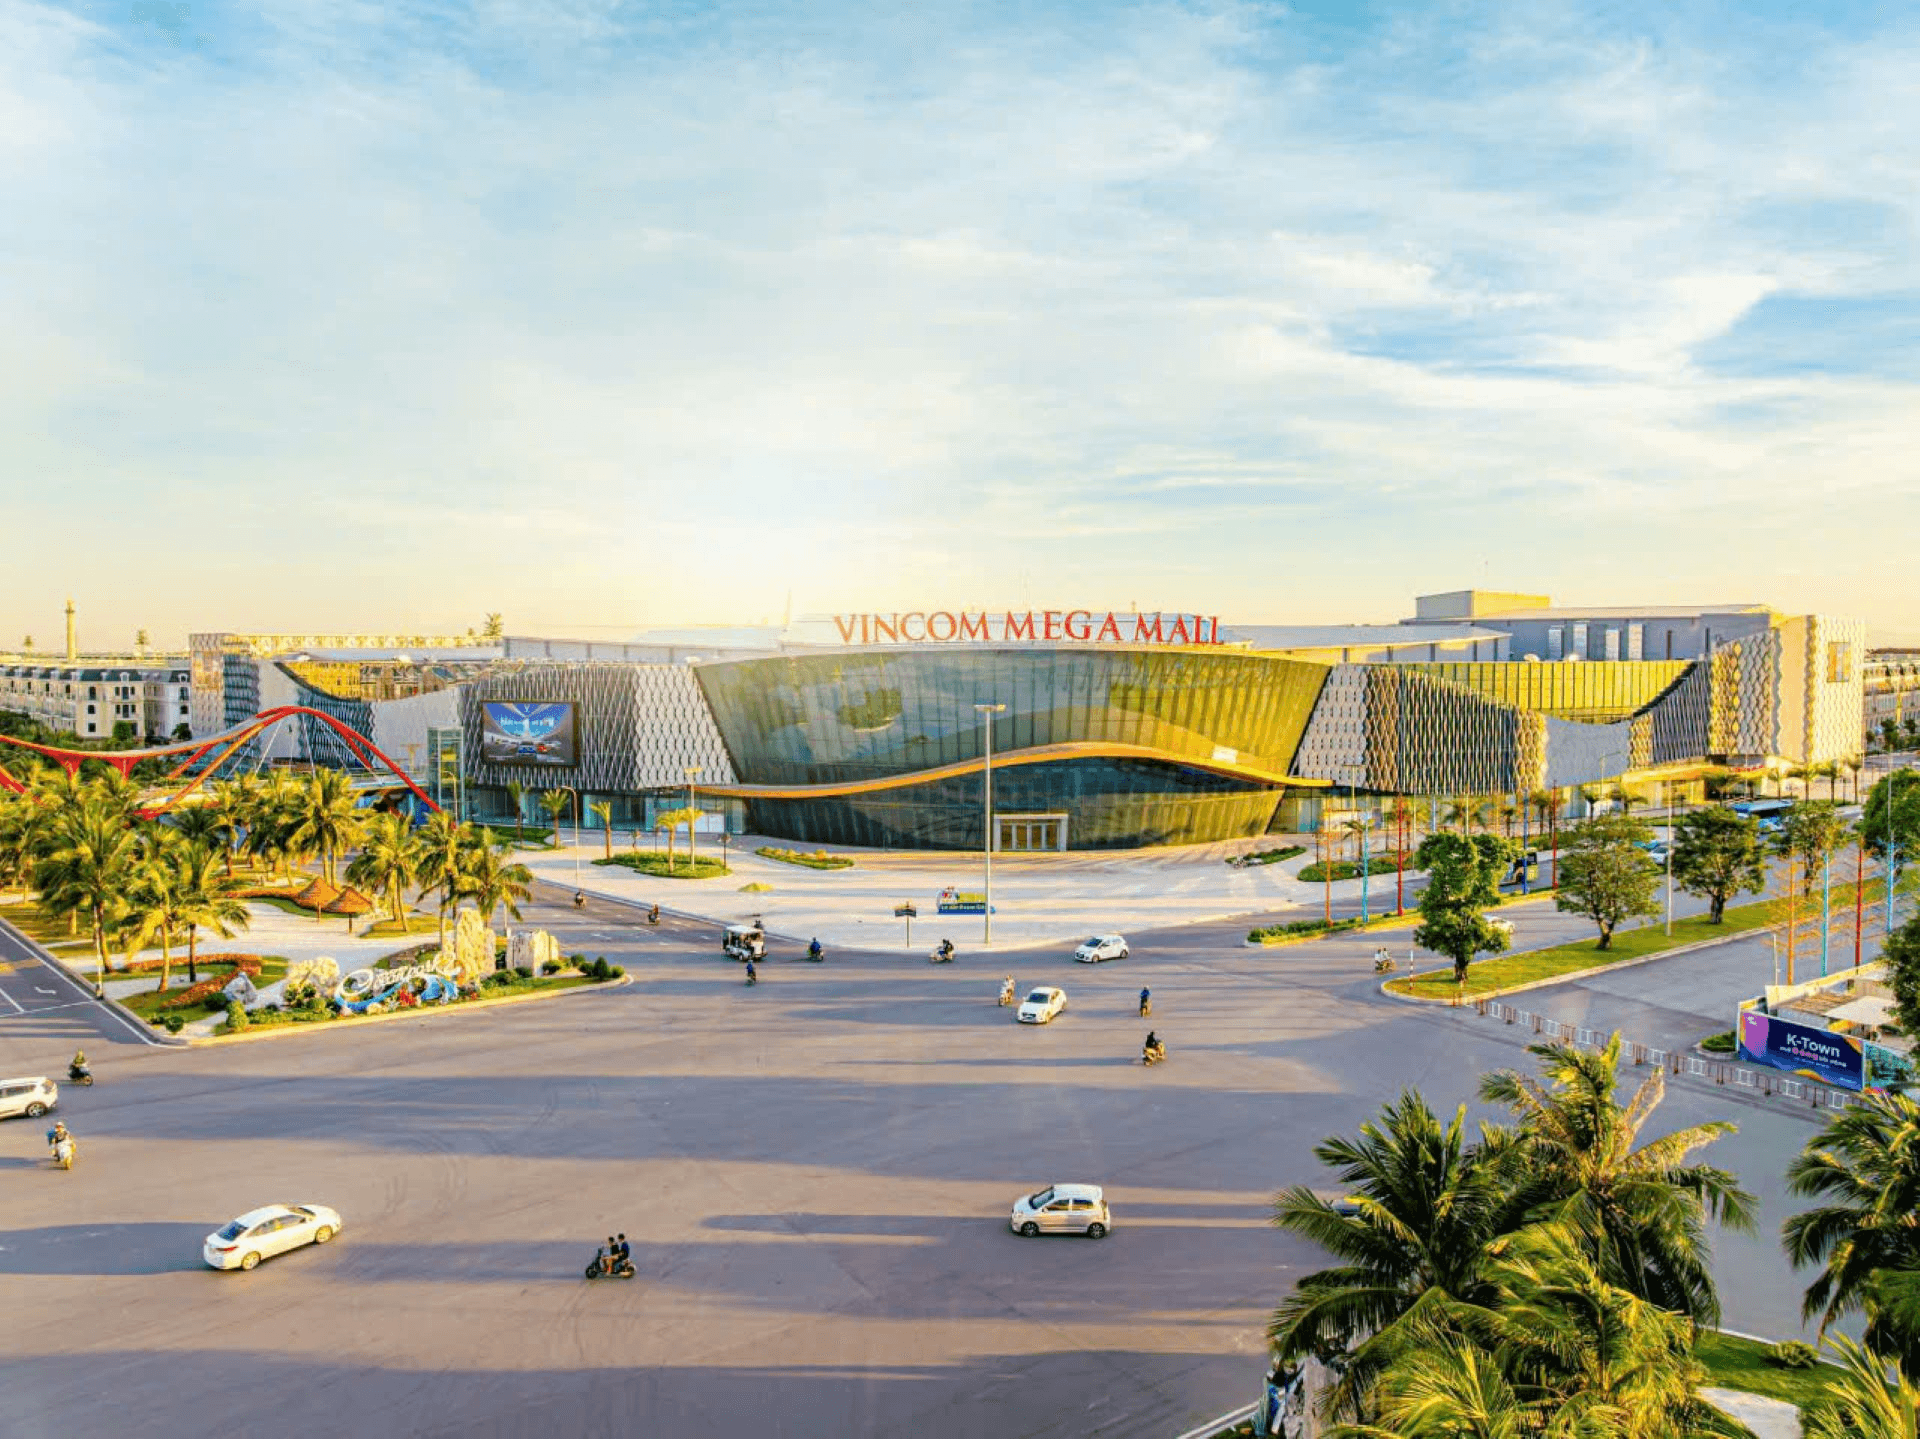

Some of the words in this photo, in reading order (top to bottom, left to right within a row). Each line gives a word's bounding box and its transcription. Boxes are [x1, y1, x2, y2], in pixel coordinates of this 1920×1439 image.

[833, 611, 991, 643] VINCOM
[1004, 610, 1122, 642] MEGA
[1134, 613, 1224, 645] MALL
[1787, 1034, 1840, 1057] K-Town
